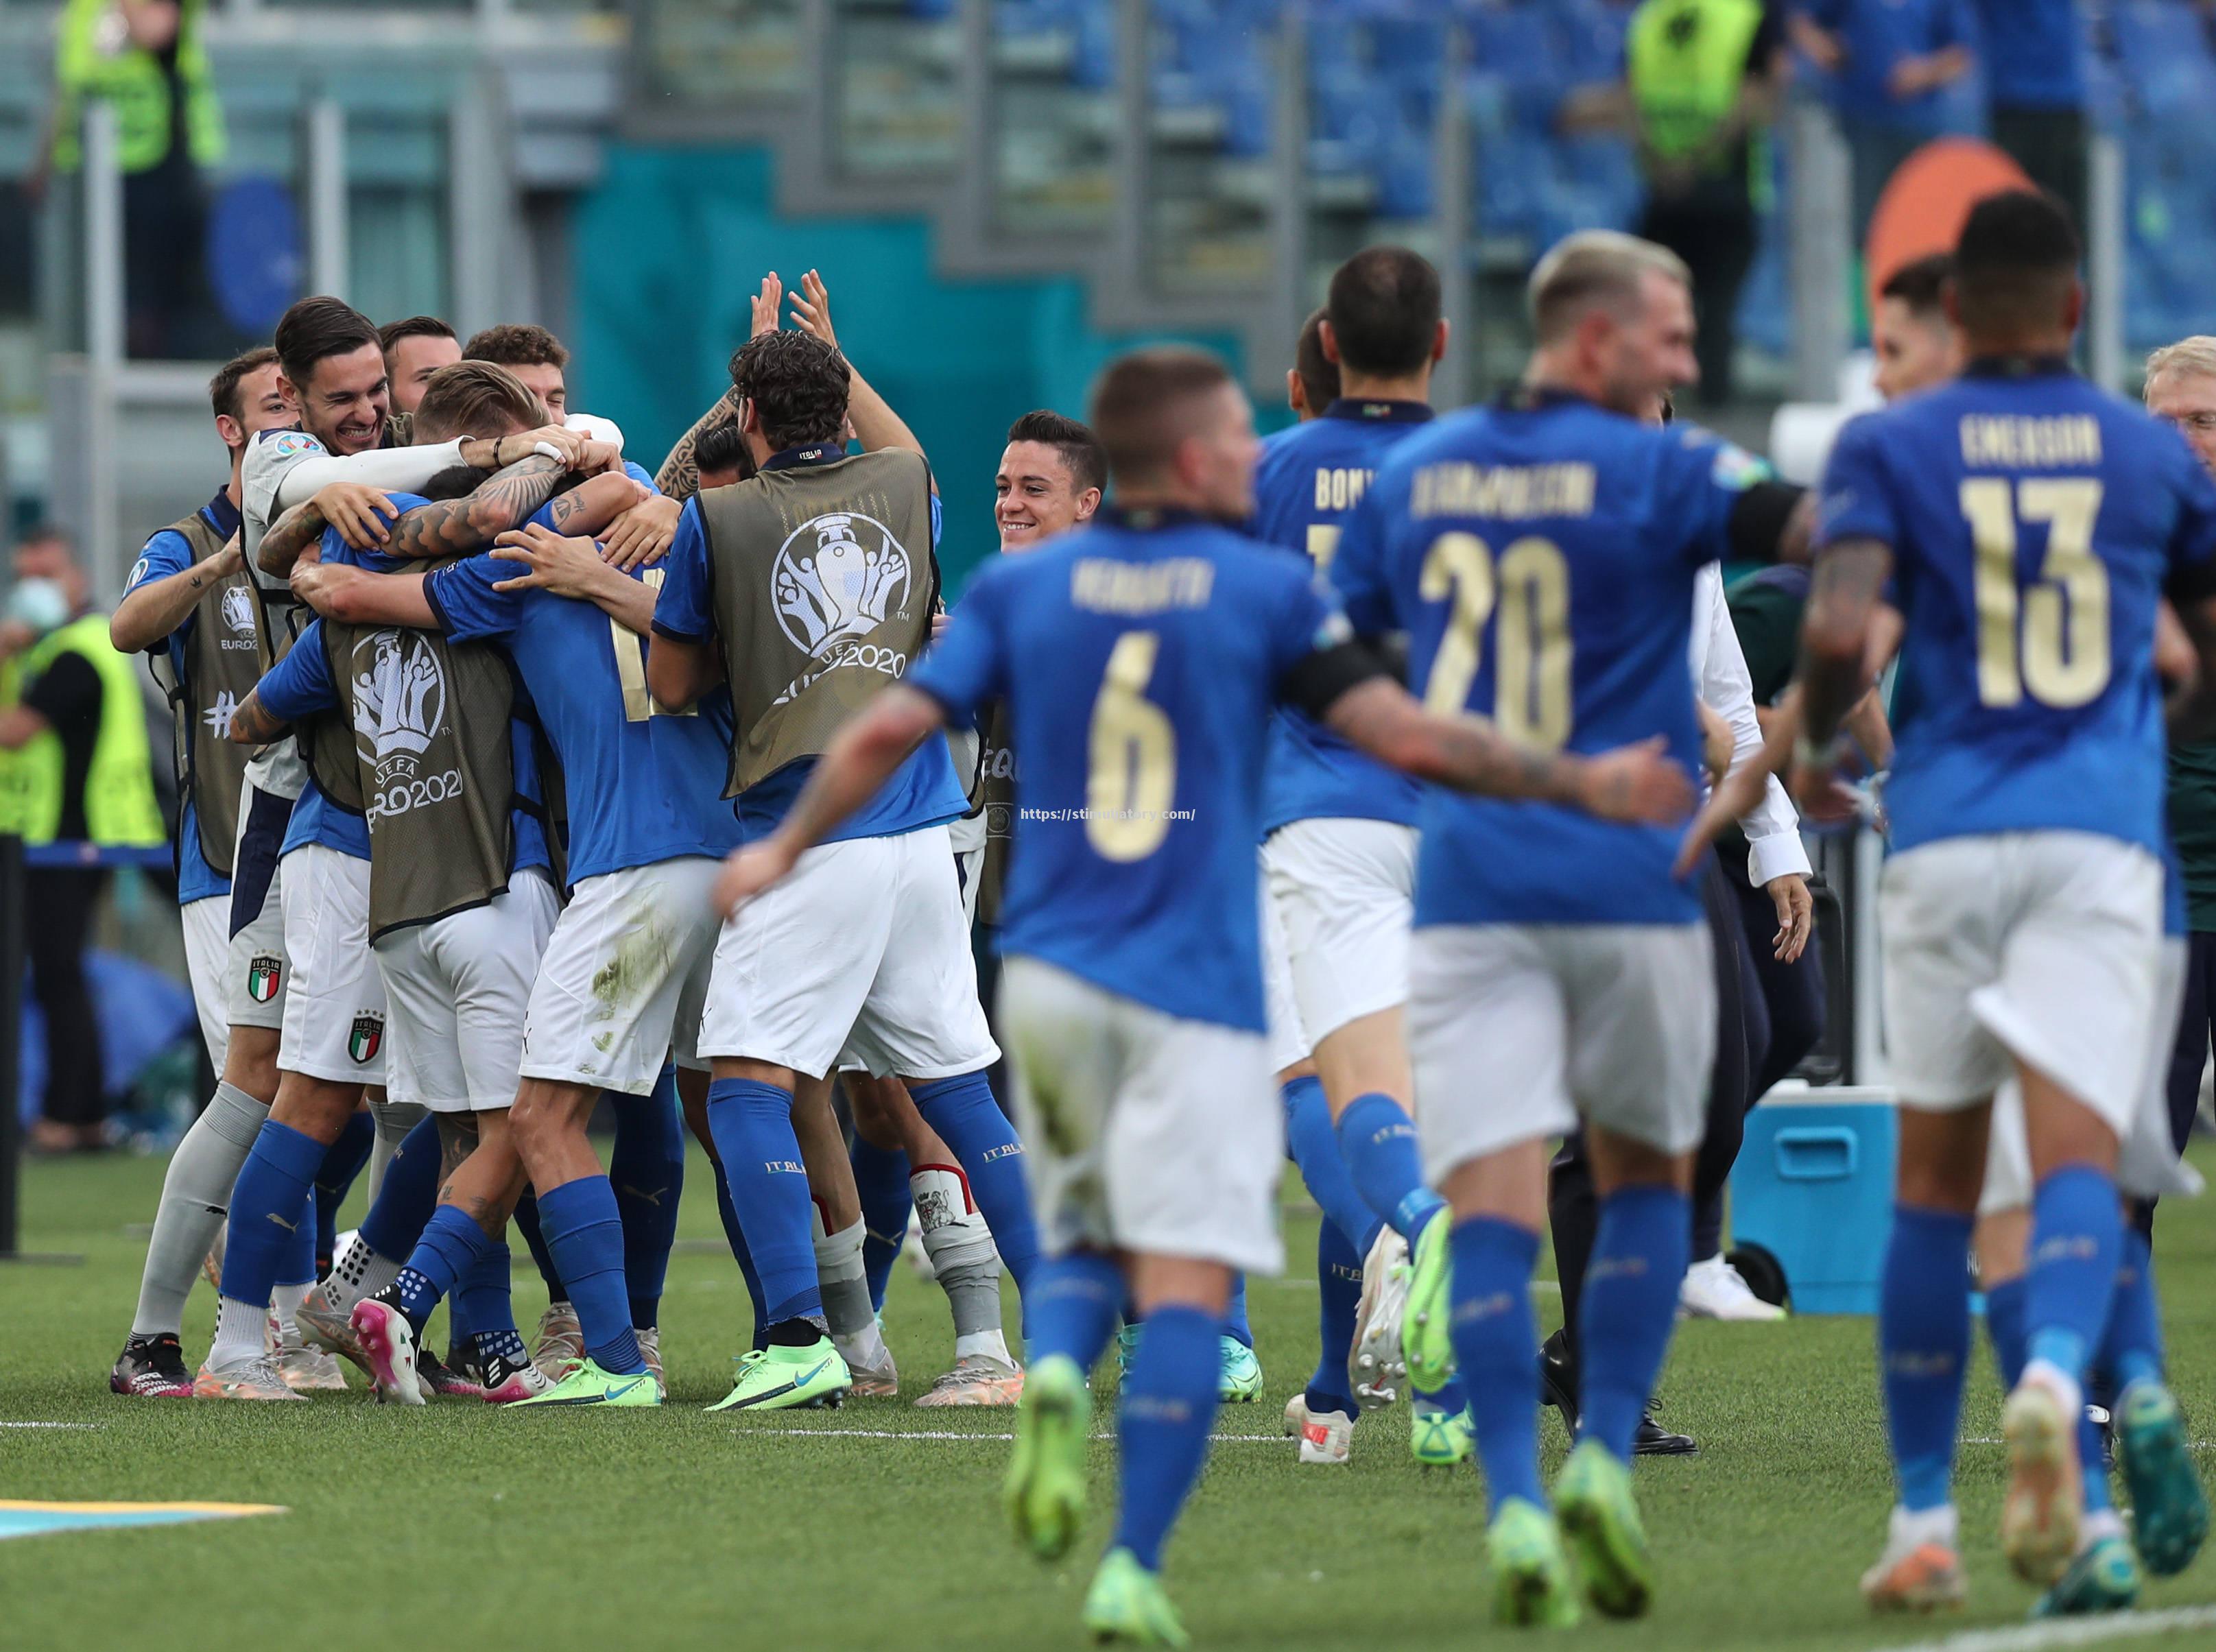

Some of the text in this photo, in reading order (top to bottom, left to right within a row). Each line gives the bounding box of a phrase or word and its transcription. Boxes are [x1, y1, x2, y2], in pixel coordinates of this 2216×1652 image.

[799, 449, 822, 459] ITALIA
[1418, 531, 1573, 754] 20
[1960, 477, 2111, 709] 13
[1086, 630, 1177, 863] 6
[252, 959, 280, 970] ITALIA
[355, 1020, 381, 1030] ITALIA
